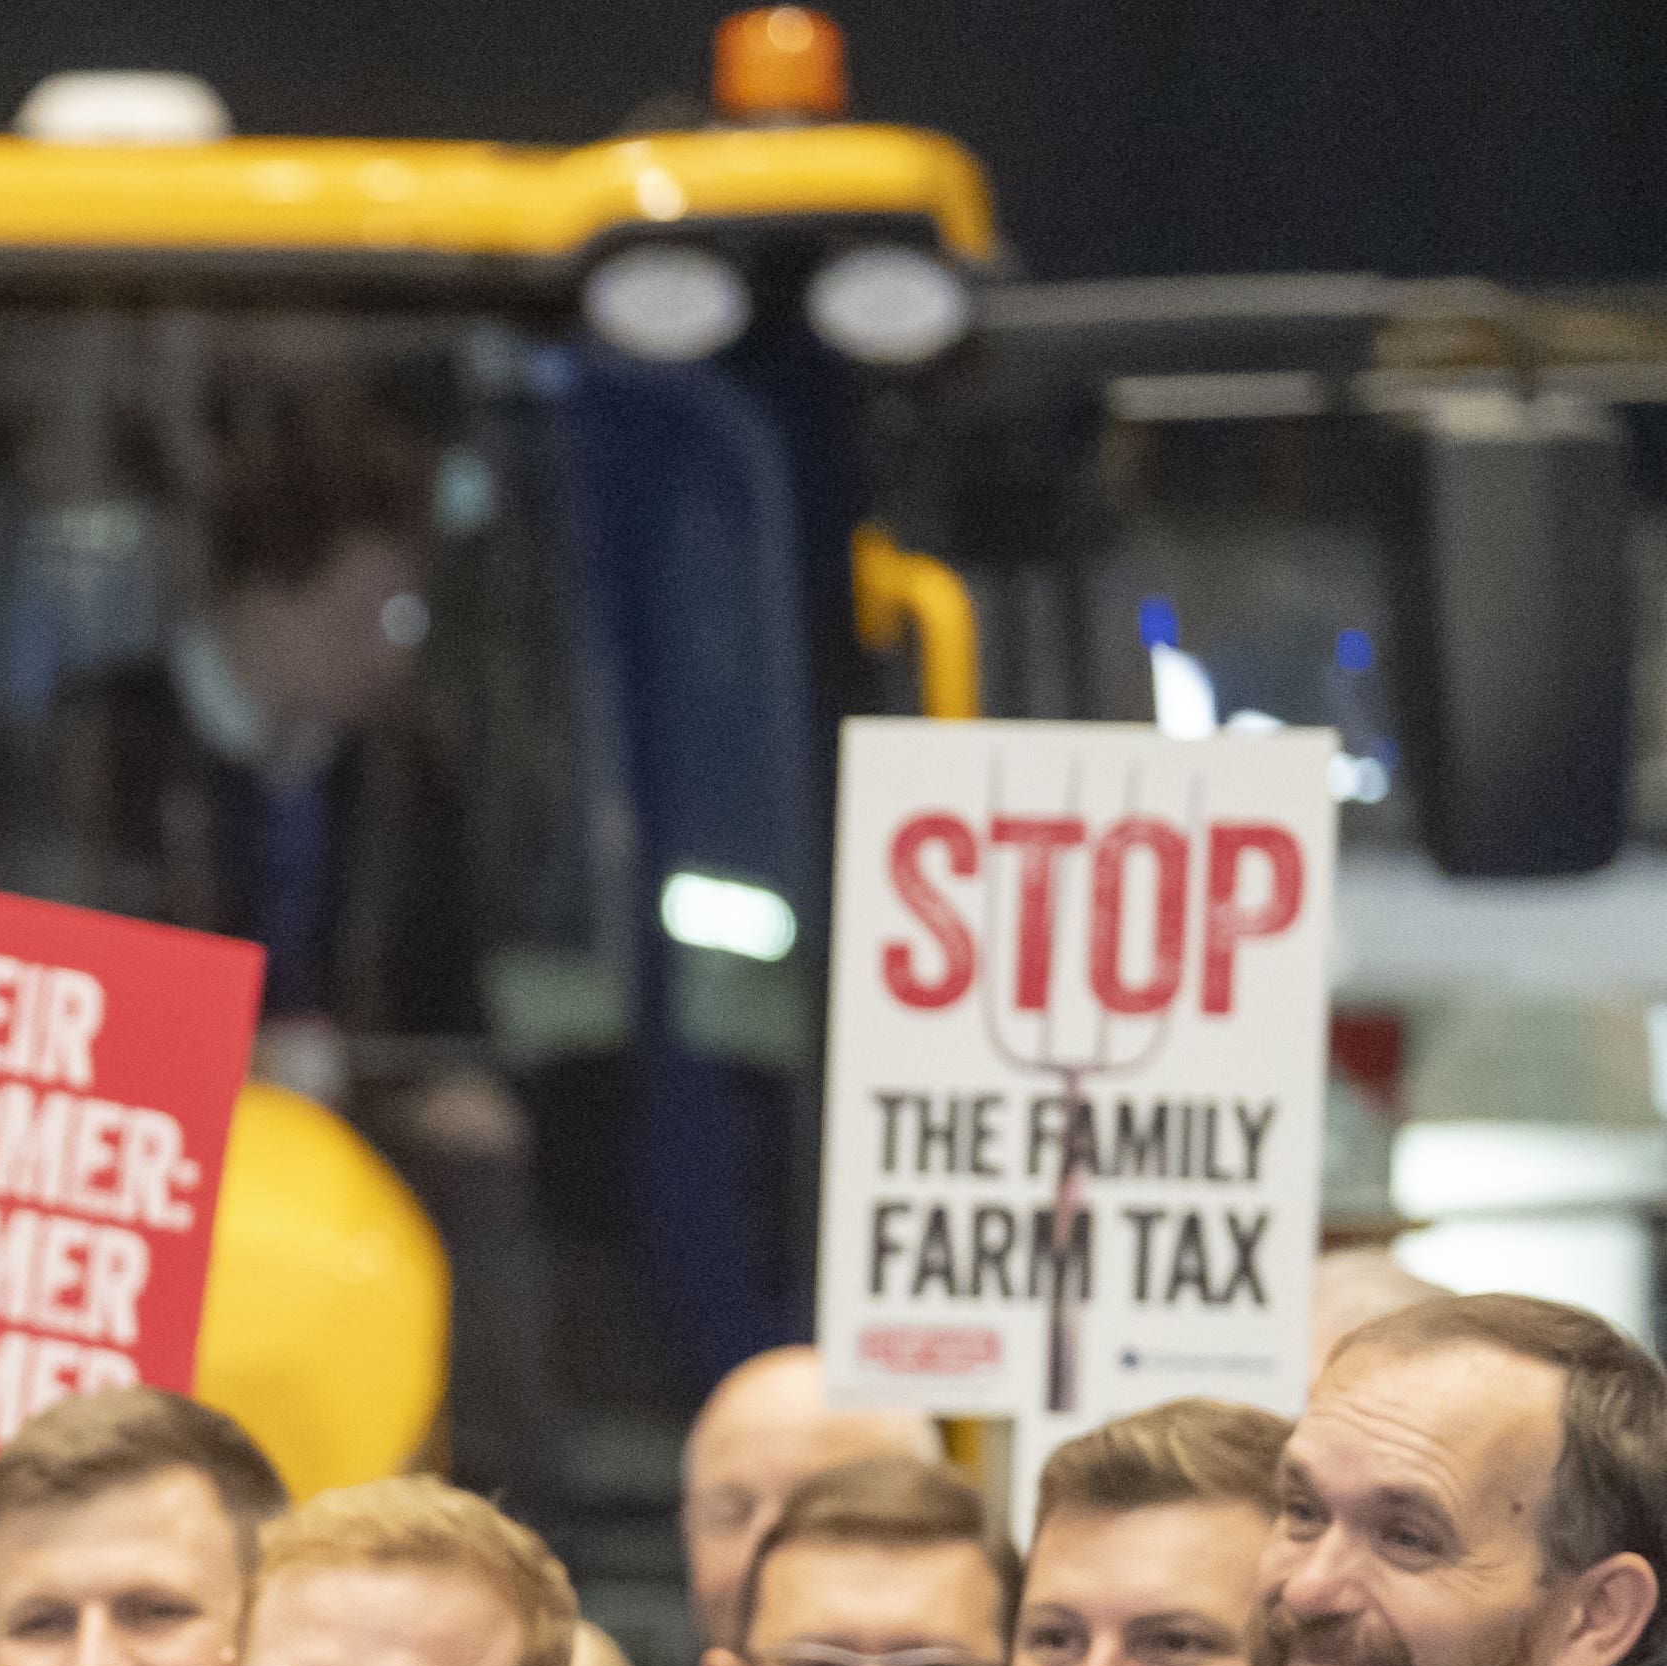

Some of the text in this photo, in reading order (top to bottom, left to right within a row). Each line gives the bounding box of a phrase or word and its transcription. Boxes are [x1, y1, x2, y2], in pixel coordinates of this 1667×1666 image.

[879, 812, 1307, 1017] STOP
[870, 1091, 1277, 1182] THE FAMILY
[867, 1206, 1273, 1306] FARM TAX
